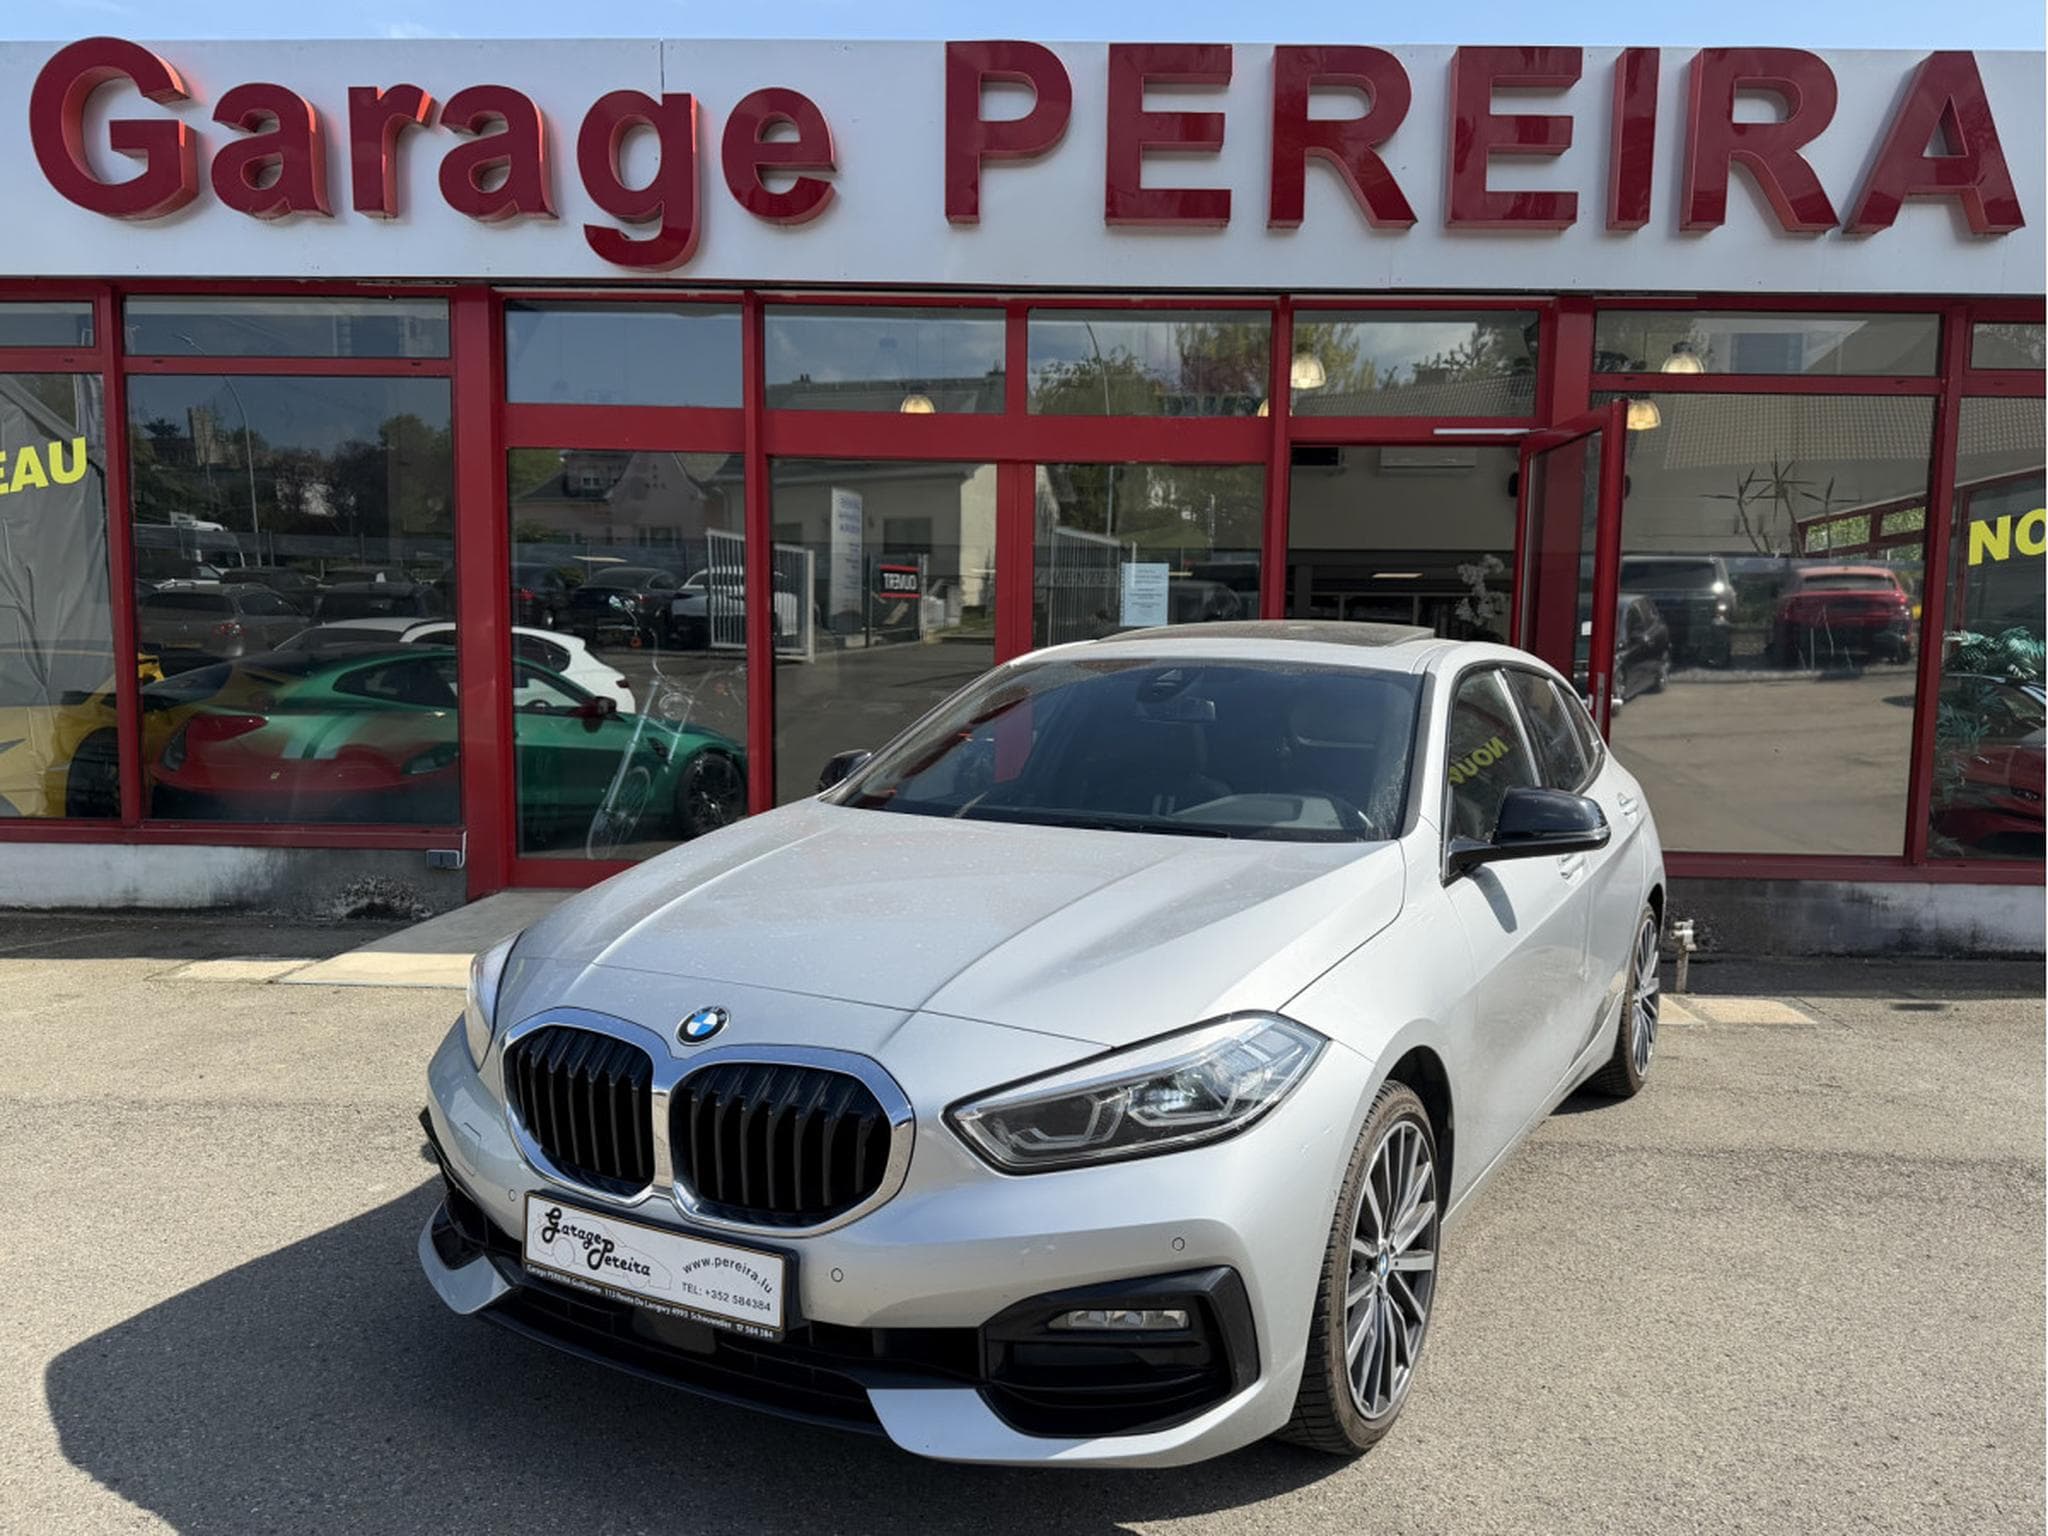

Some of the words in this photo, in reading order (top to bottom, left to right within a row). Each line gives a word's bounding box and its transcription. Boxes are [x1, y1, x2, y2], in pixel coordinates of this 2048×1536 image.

[29, 36, 838, 272] Garage
[945, 40, 2026, 237] PEREIRA
[541, 1207, 603, 1250] Garage
[587, 1239, 650, 1276] Pereira
[682, 1256, 773, 1294] www.pereira.lu
[682, 1282, 702, 1296] TEL:
[705, 1289, 729, 1303] +352
[731, 1295, 771, 1312] 584384
